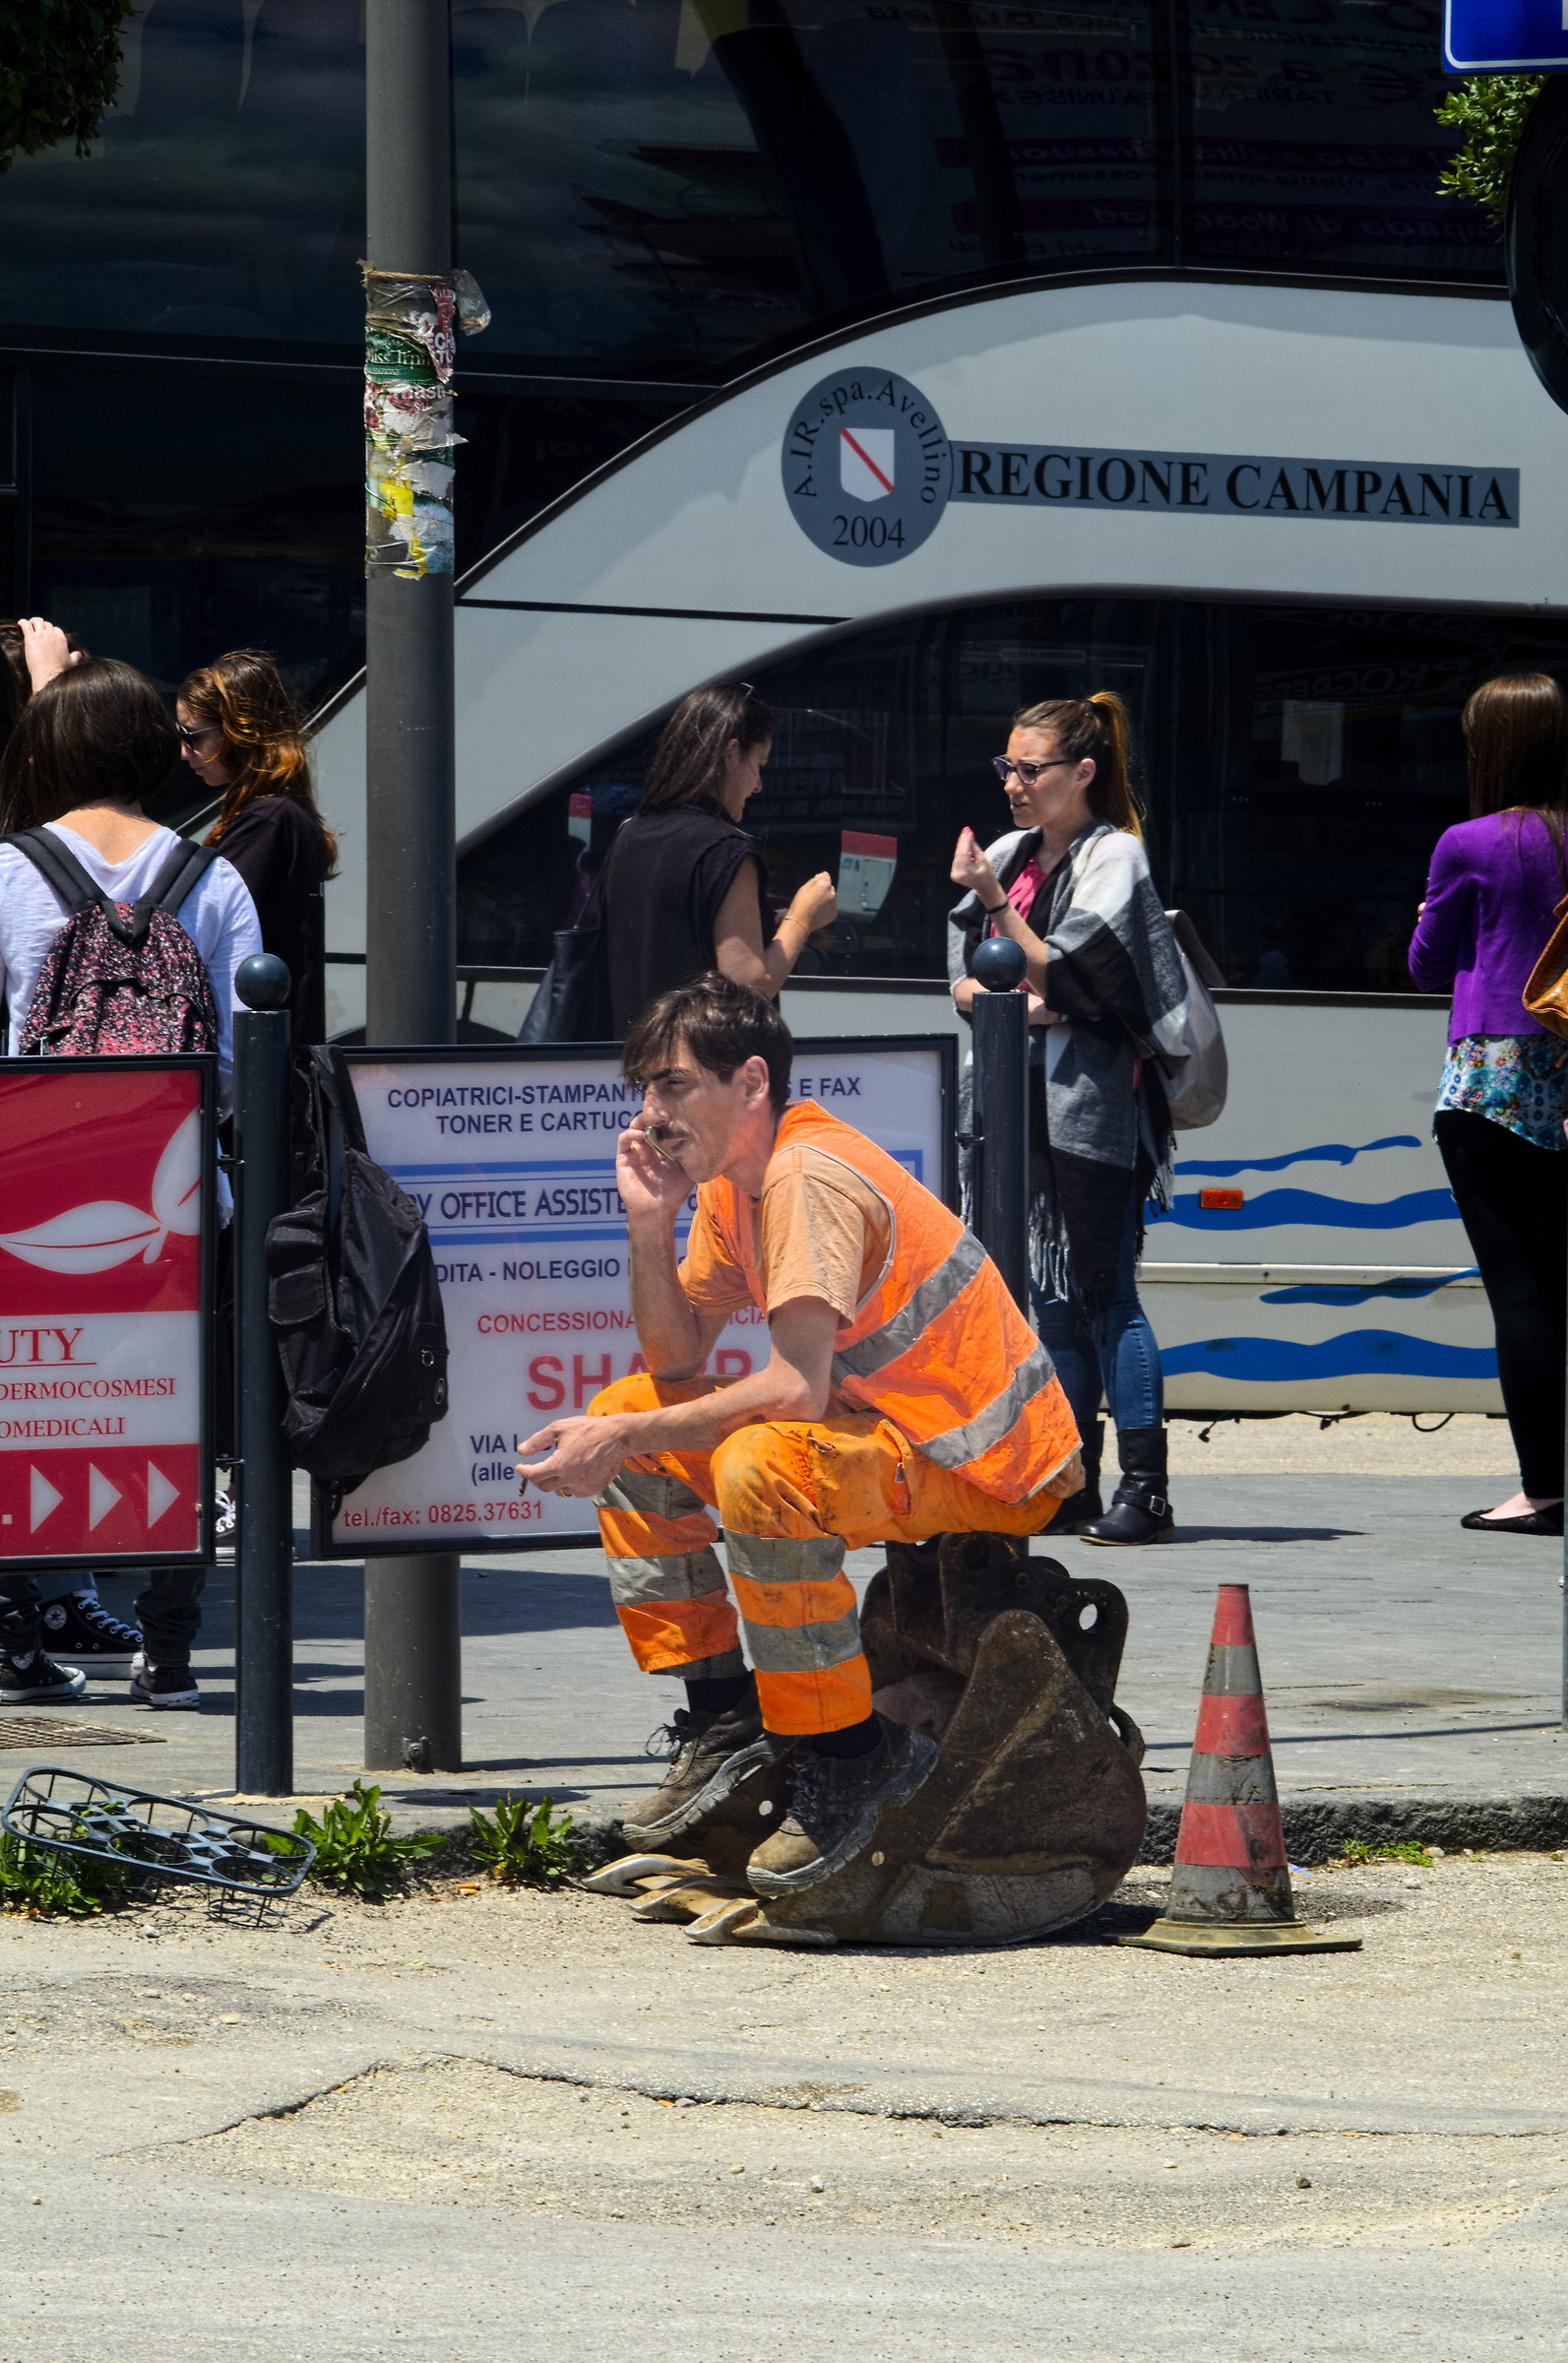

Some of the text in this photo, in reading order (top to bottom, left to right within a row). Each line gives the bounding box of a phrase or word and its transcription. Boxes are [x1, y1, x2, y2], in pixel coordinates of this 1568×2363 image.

[958, 449, 1513, 520] REGIONE CAMPANIA
[833, 514, 906, 548] 2004
[799, 1078, 812, 1097] E
[820, 1077, 861, 1096] FAX
[437, 1110, 643, 1134] TONER E CARTUC
[441, 1190, 526, 1220] OFFICE
[503, 1258, 620, 1280] NOLEGGIO
[470, 1434, 507, 1454] VIA
[471, 1461, 515, 1487] (alle
[344, 1501, 542, 1527] tel./fax: 0825.37631
